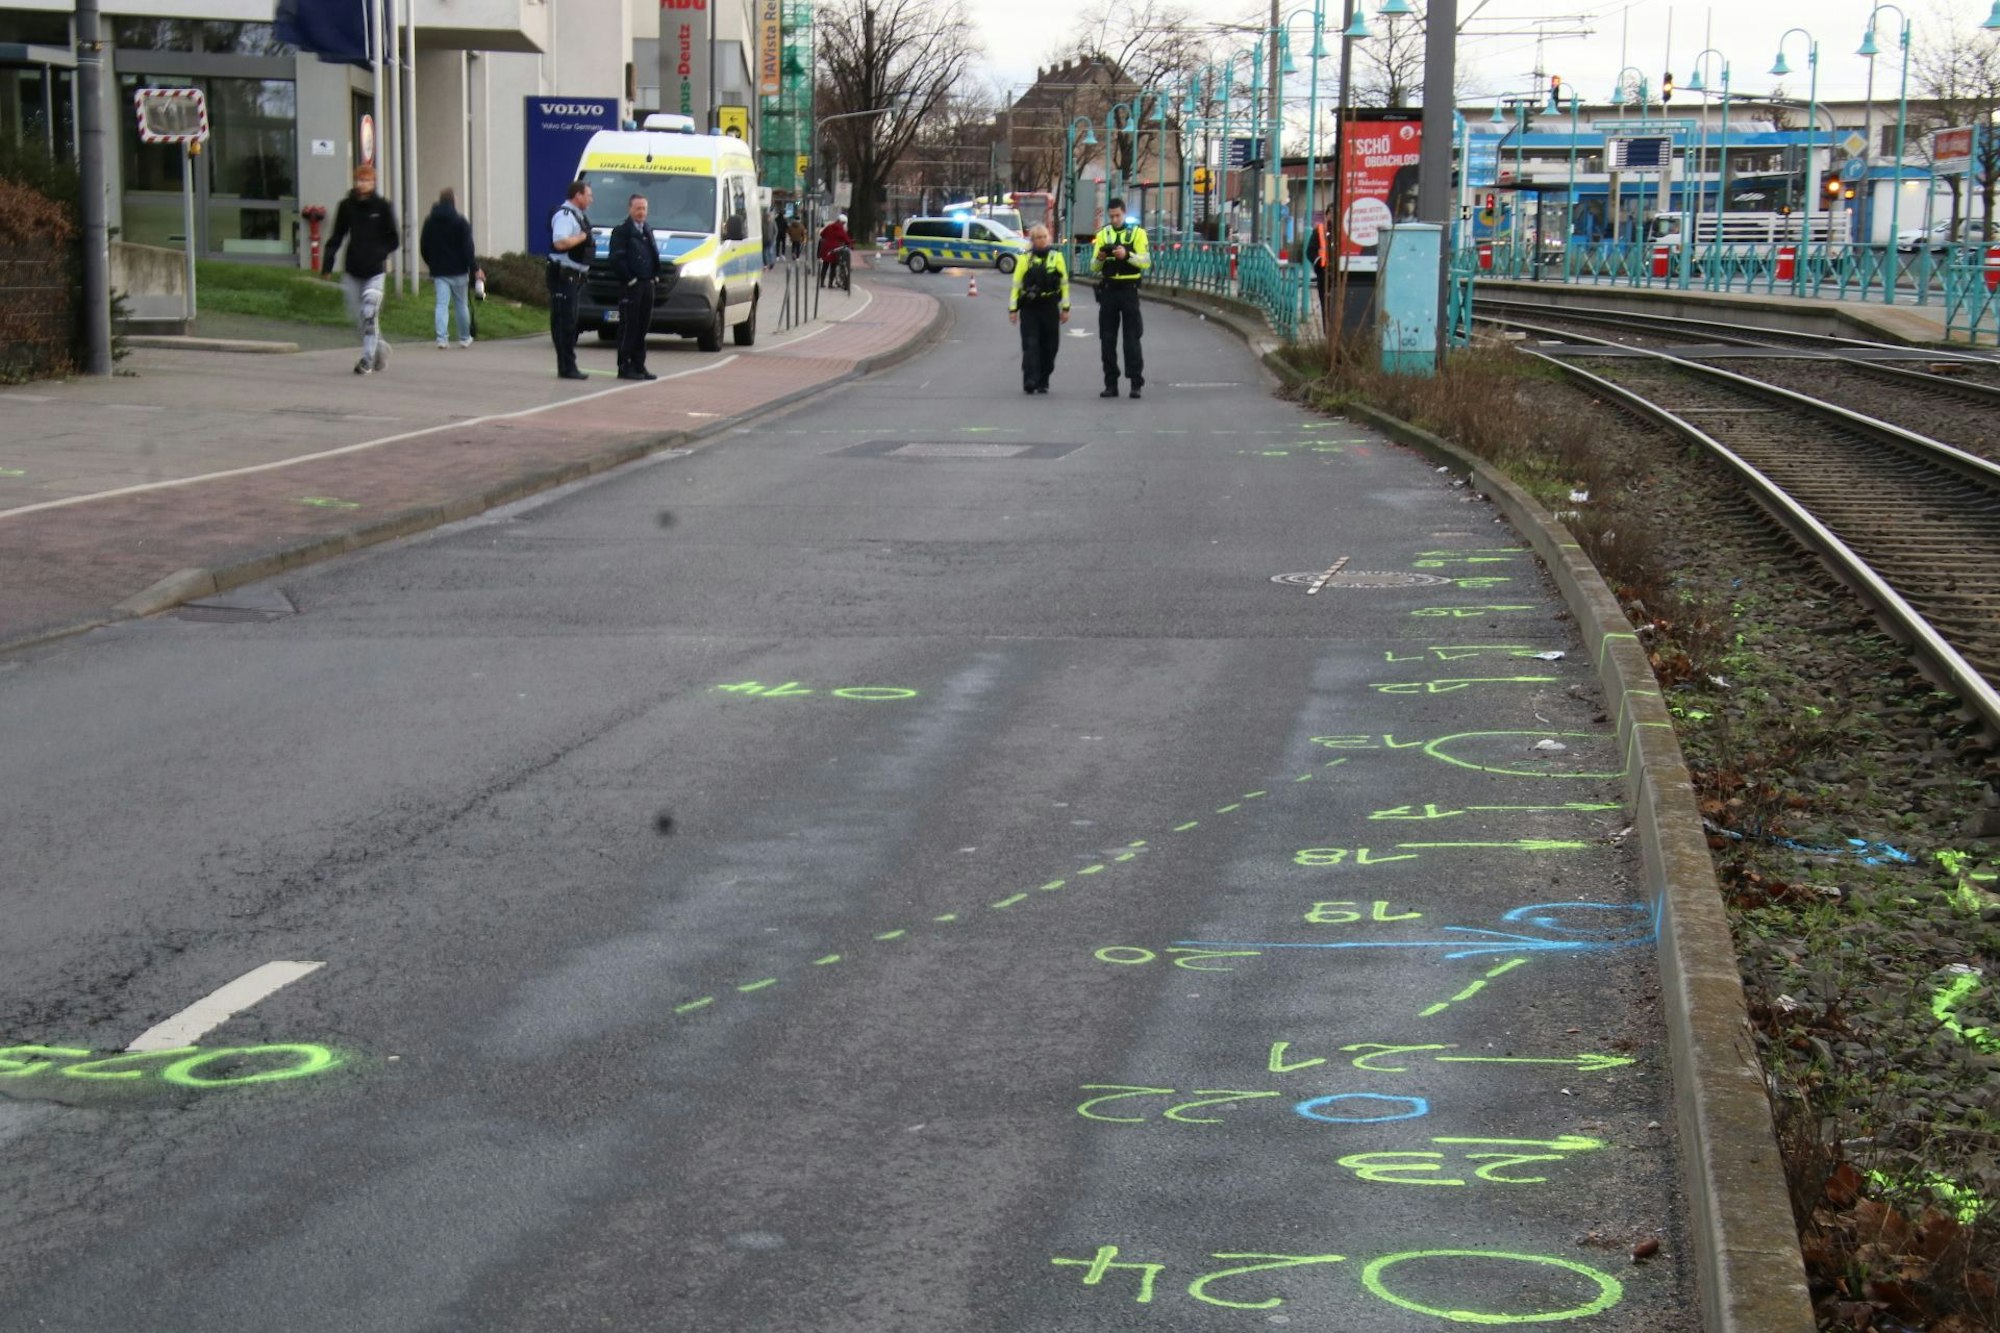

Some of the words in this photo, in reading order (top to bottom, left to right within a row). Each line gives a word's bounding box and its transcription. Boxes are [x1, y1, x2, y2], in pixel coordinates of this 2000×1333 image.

[539, 103, 605, 115] VOLVO
[542, 122, 560, 130] Volvo
[561, 122, 573, 130] Car
[599, 162, 697, 173] UNFALLAUFNAHME
[1294, 847, 1418, 866] 18
[1303, 900, 1423, 924] 19
[1051, 1244, 1347, 1309] 24
